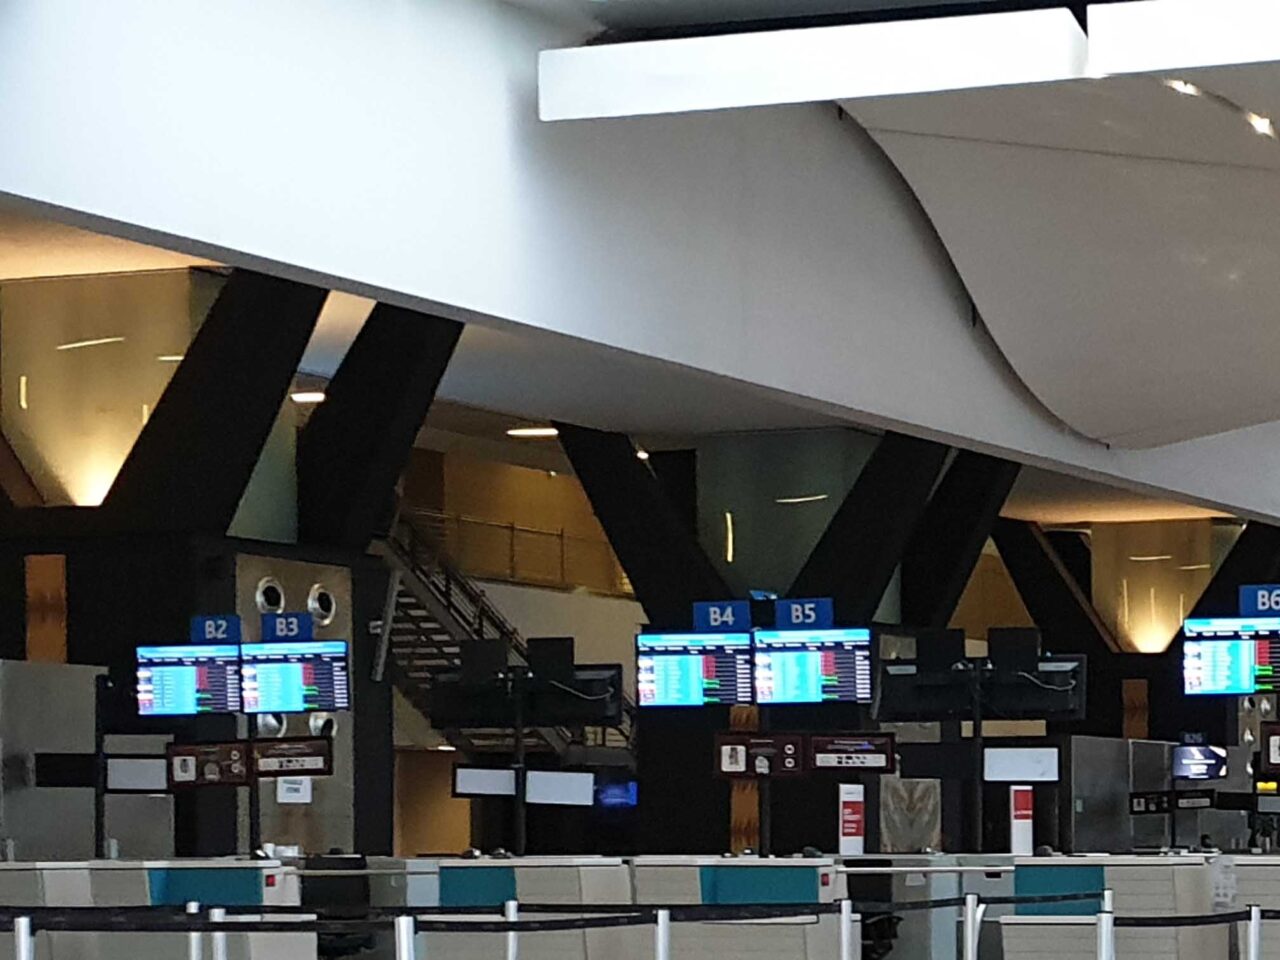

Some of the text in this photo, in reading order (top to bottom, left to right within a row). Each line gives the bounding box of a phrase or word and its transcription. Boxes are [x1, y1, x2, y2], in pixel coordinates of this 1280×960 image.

[708, 606, 735, 626] B4
[790, 603, 816, 624] B5
[204, 620, 228, 639] B2
[275, 617, 299, 636] B3
